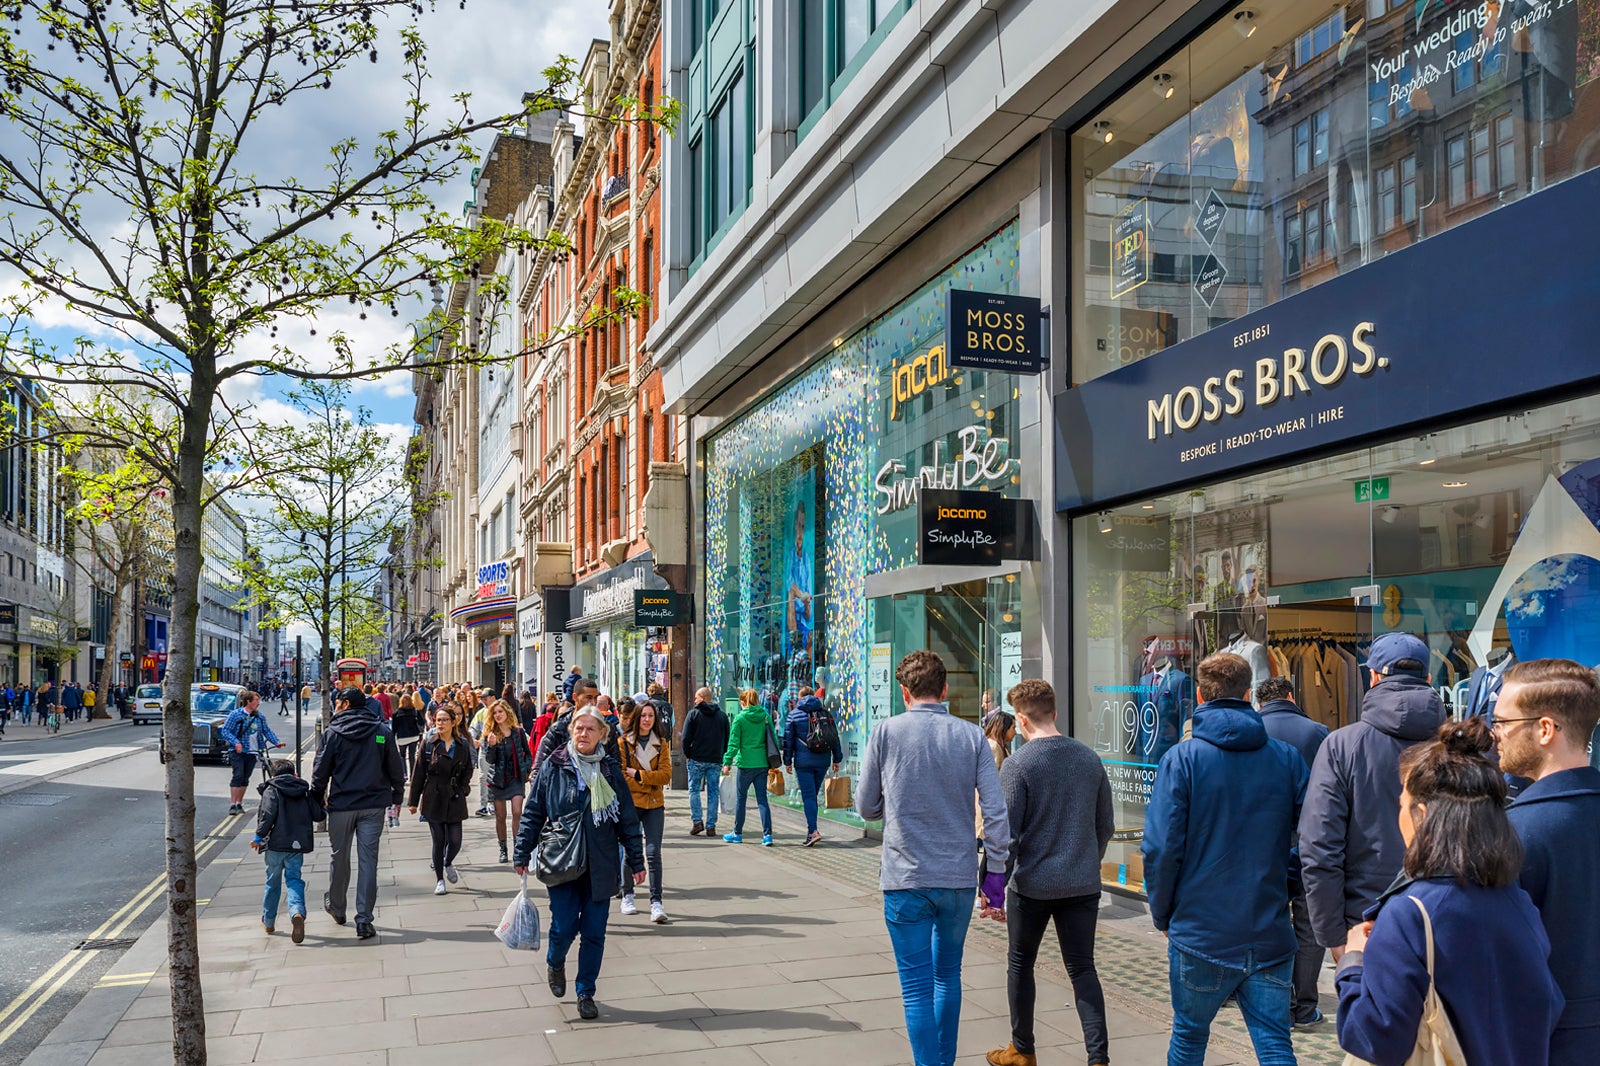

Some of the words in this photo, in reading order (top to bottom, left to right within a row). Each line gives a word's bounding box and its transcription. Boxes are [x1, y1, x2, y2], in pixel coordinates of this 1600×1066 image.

[1371, 49, 1409, 83] Your
[1413, 0, 1493, 59] wedding,
[1388, 63, 1441, 107] Bespoke,
[1443, 34, 1491, 75] Ready
[1493, 27, 1507, 47] to
[1510, 2, 1552, 35] wear,
[1203, 213, 1220, 226] deposit
[1114, 230, 1144, 260] TED
[1202, 268, 1219, 281] Groom
[1210, 277, 1221, 287] free
[967, 308, 1025, 331] MOSS
[967, 330, 1030, 354] BROS.
[1233, 323, 1271, 348] EST.1851
[1147, 368, 1245, 440] MOSS
[1256, 321, 1390, 406] BROS.
[1180, 443, 1216, 463] BESPOKE
[1226, 416, 1306, 450] READY-TO-WEAR
[1318, 406, 1344, 425] HIRE
[937, 505, 987, 520] jacamo
[927, 529, 997, 549] SimplyBe
[478, 561, 507, 584] SPORTS
[642, 597, 670, 605] jacamo
[637, 608, 675, 618] SimplyBe
[552, 632, 565, 681] Apparel
[1091, 701, 1160, 755] £199
[1113, 768, 1131, 779] NEW
[1117, 793, 1141, 804] QUALITY
